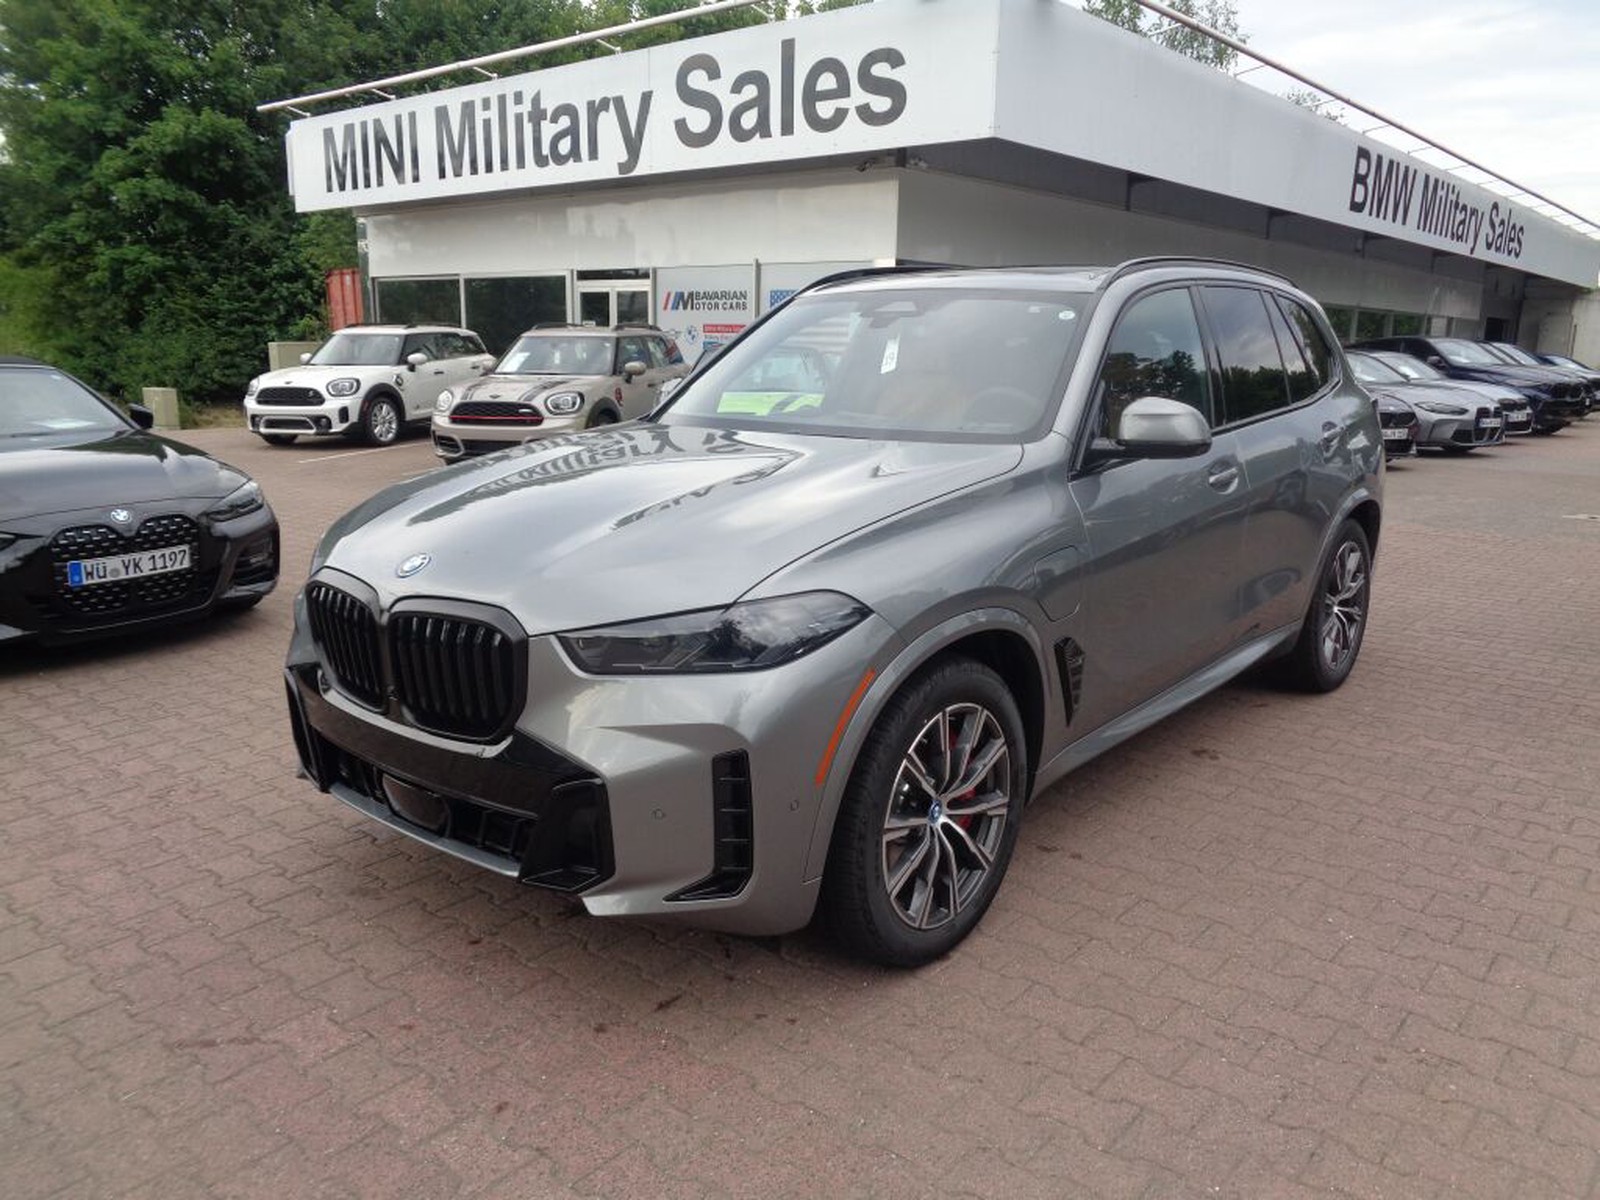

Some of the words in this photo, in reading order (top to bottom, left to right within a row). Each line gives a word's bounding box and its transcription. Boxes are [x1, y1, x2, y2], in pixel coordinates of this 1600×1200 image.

[322, 111, 420, 194] MINI
[435, 90, 653, 179] Military
[674, 38, 907, 149] Sales
[1349, 145, 1417, 226] BMW
[1417, 173, 1484, 255] Military
[1485, 201, 1525, 259] Sales
[694, 290, 748, 301] BAVARIAN
[722, 301, 748, 311] CARS
[121, 557, 143, 575] YK
[148, 549, 187, 572] 1197
